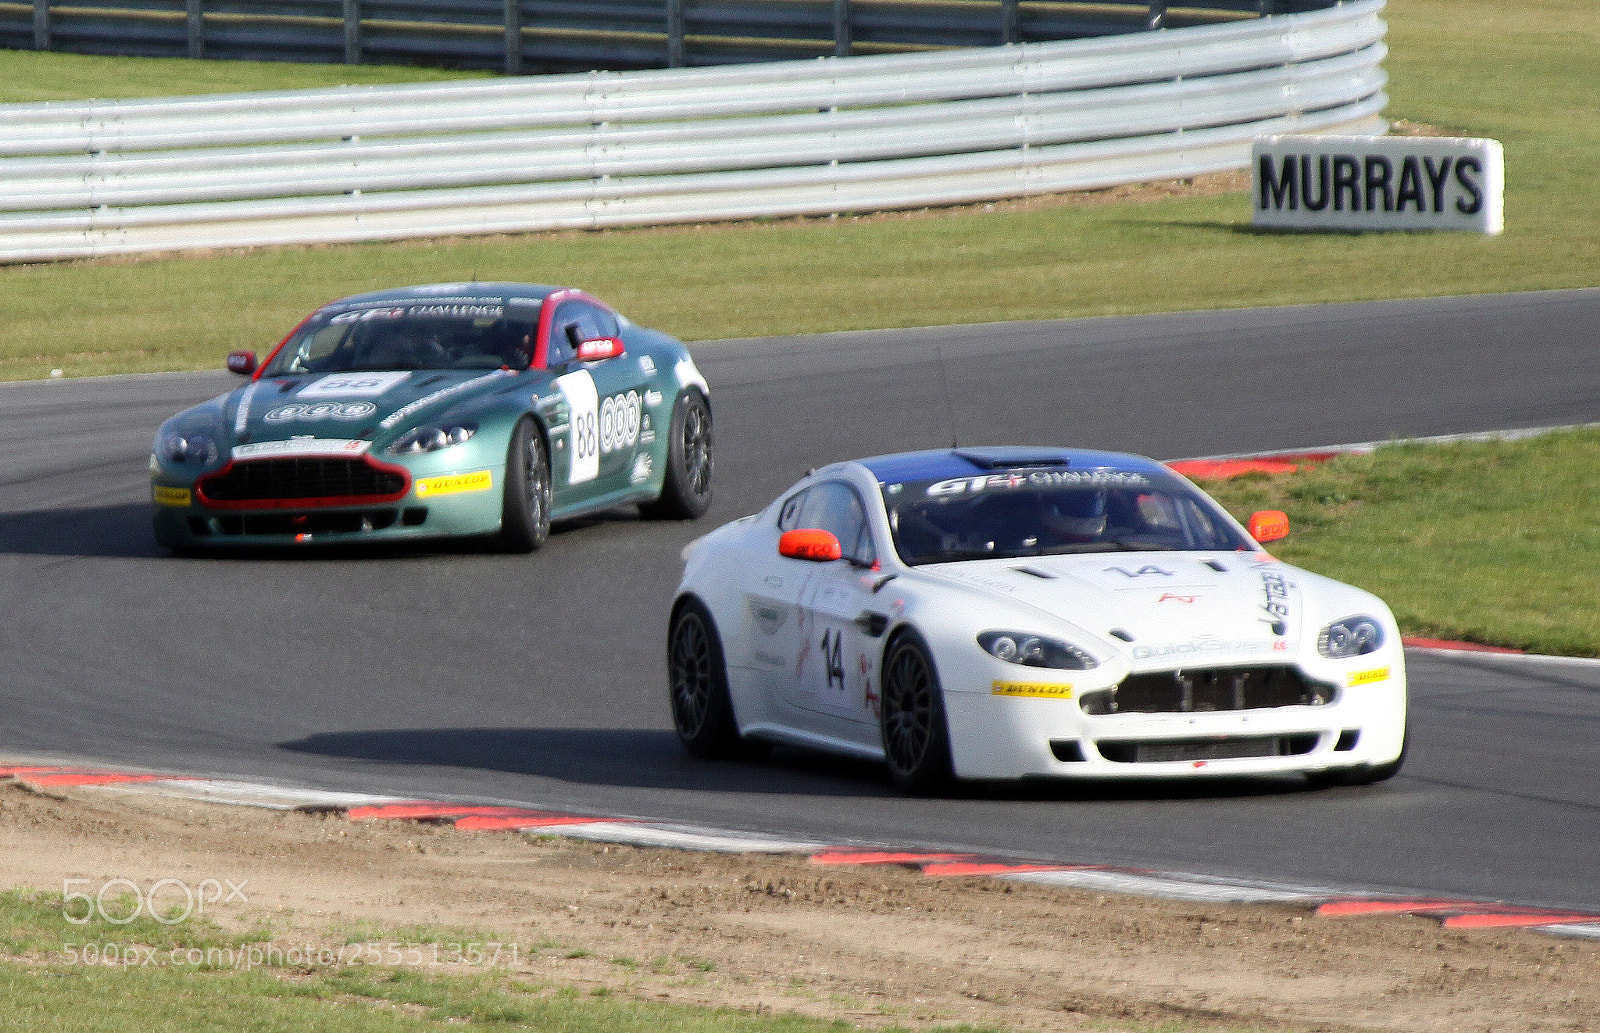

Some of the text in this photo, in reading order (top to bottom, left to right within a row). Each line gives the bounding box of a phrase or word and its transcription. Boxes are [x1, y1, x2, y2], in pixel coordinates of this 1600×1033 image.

[1260, 154, 1484, 214] MURRAYS
[577, 410, 596, 459] 88
[433, 474, 488, 488] DUNLOP
[821, 627, 845, 690] 14
[1006, 685, 1070, 694] DUNLOP
